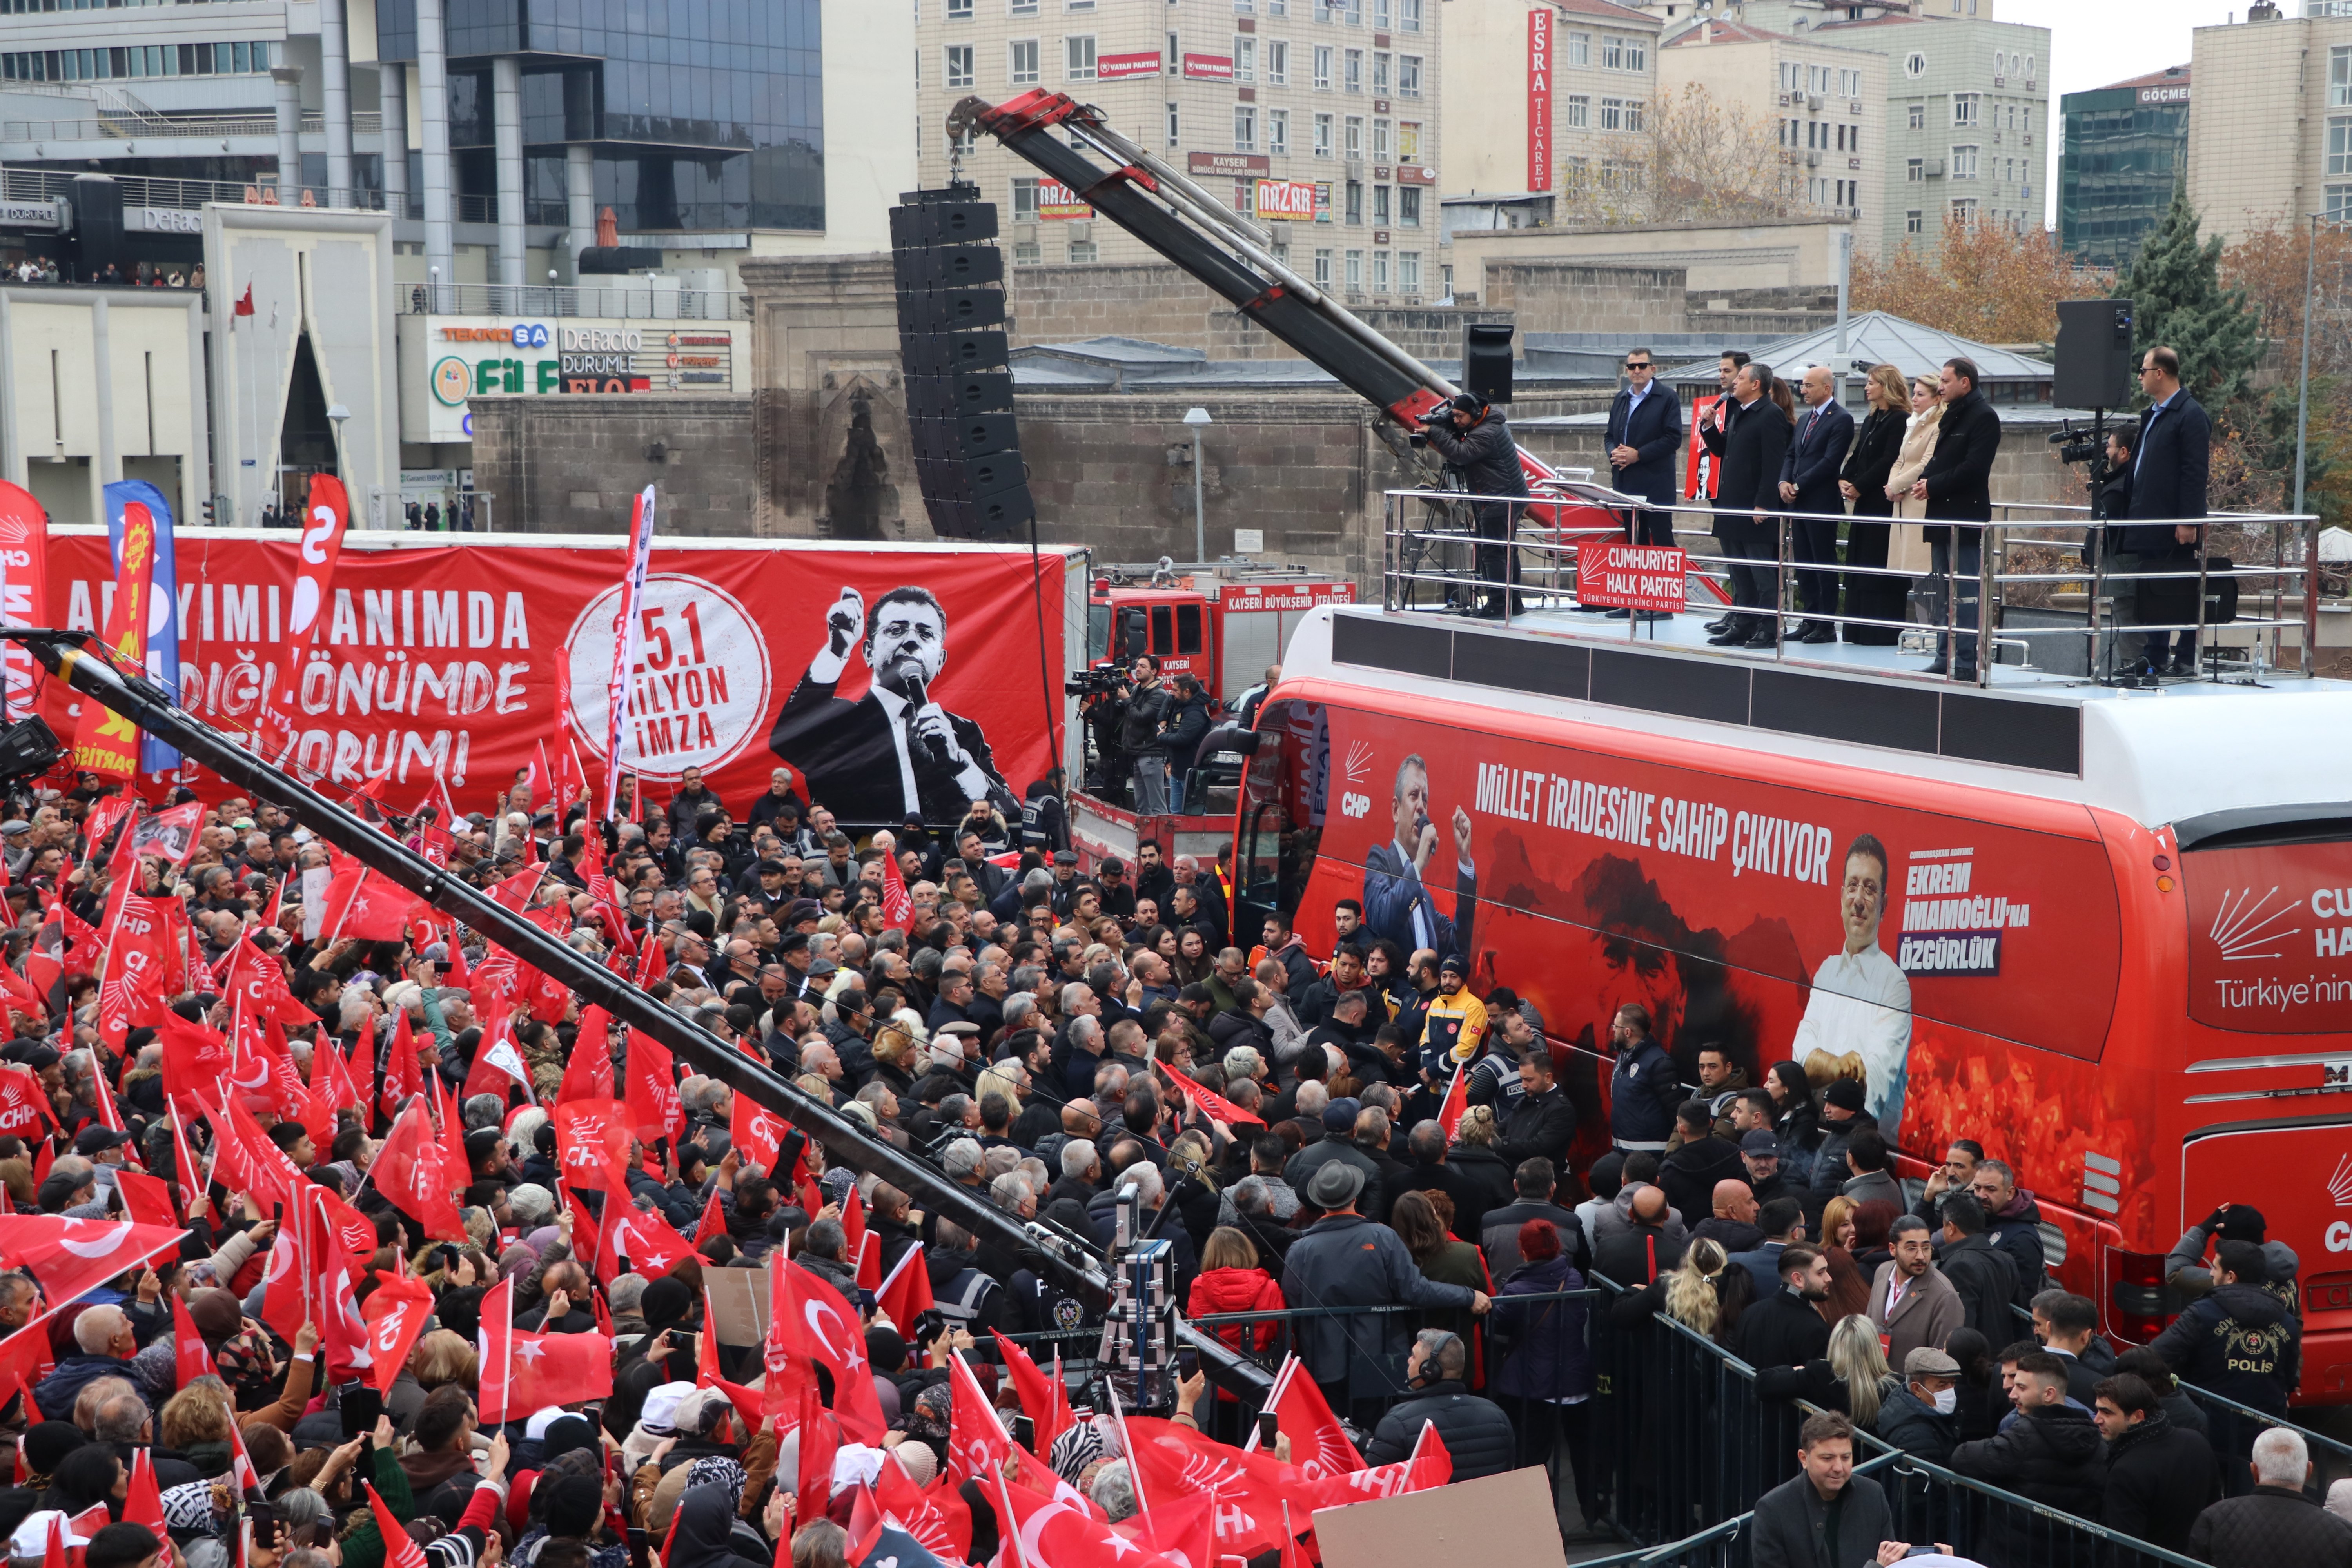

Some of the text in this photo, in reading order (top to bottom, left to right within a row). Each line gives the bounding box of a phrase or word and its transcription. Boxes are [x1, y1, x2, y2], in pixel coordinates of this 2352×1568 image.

[1110, 60, 1158, 71] VATAN PARTİSİ
[1195, 63, 1232, 73] VATAN PARTİSİ
[1532, 13, 1546, 189] ESRA TİCARET
[1192, 166, 1267, 177] SÜRÜCÜ KURSLARI DERNEĞİ
[1214, 156, 1247, 168] KAYSERİ
[1040, 183, 1085, 205] NAZ
[1259, 182, 1311, 212] NAZAR
[564, 328, 642, 352] DeFacto
[563, 355, 637, 374] DÜRÜMLE
[1608, 547, 1683, 572] CUMHURİYET
[1606, 573, 1683, 599] HALK PARTİSİ
[1229, 594, 1263, 610] KAYSERİ
[1265, 593, 1312, 610] BÜYÜKŞEHİR
[1583, 593, 1682, 610] TÜRKİYE'NİN BİRİNCİ PARTİSİ
[311, 588, 531, 650] ANIMDA
[613, 601, 706, 675] 5.1
[1163, 657, 1190, 671] KAYSERİ
[300, 649, 531, 717] ÖNÜMDE
[636, 711, 717, 758] İMZA
[1342, 791, 1370, 819] CHP
[1475, 762, 1833, 886] MİLLET İRADESİNE SAHİP ÇIKIYOR
[1906, 862, 1972, 896] EKREM
[1899, 935, 1996, 971] ÖZGÜRLÜK
[0, 1104, 36, 1129] CHP
[2227, 1358, 2273, 1374] POLİS
